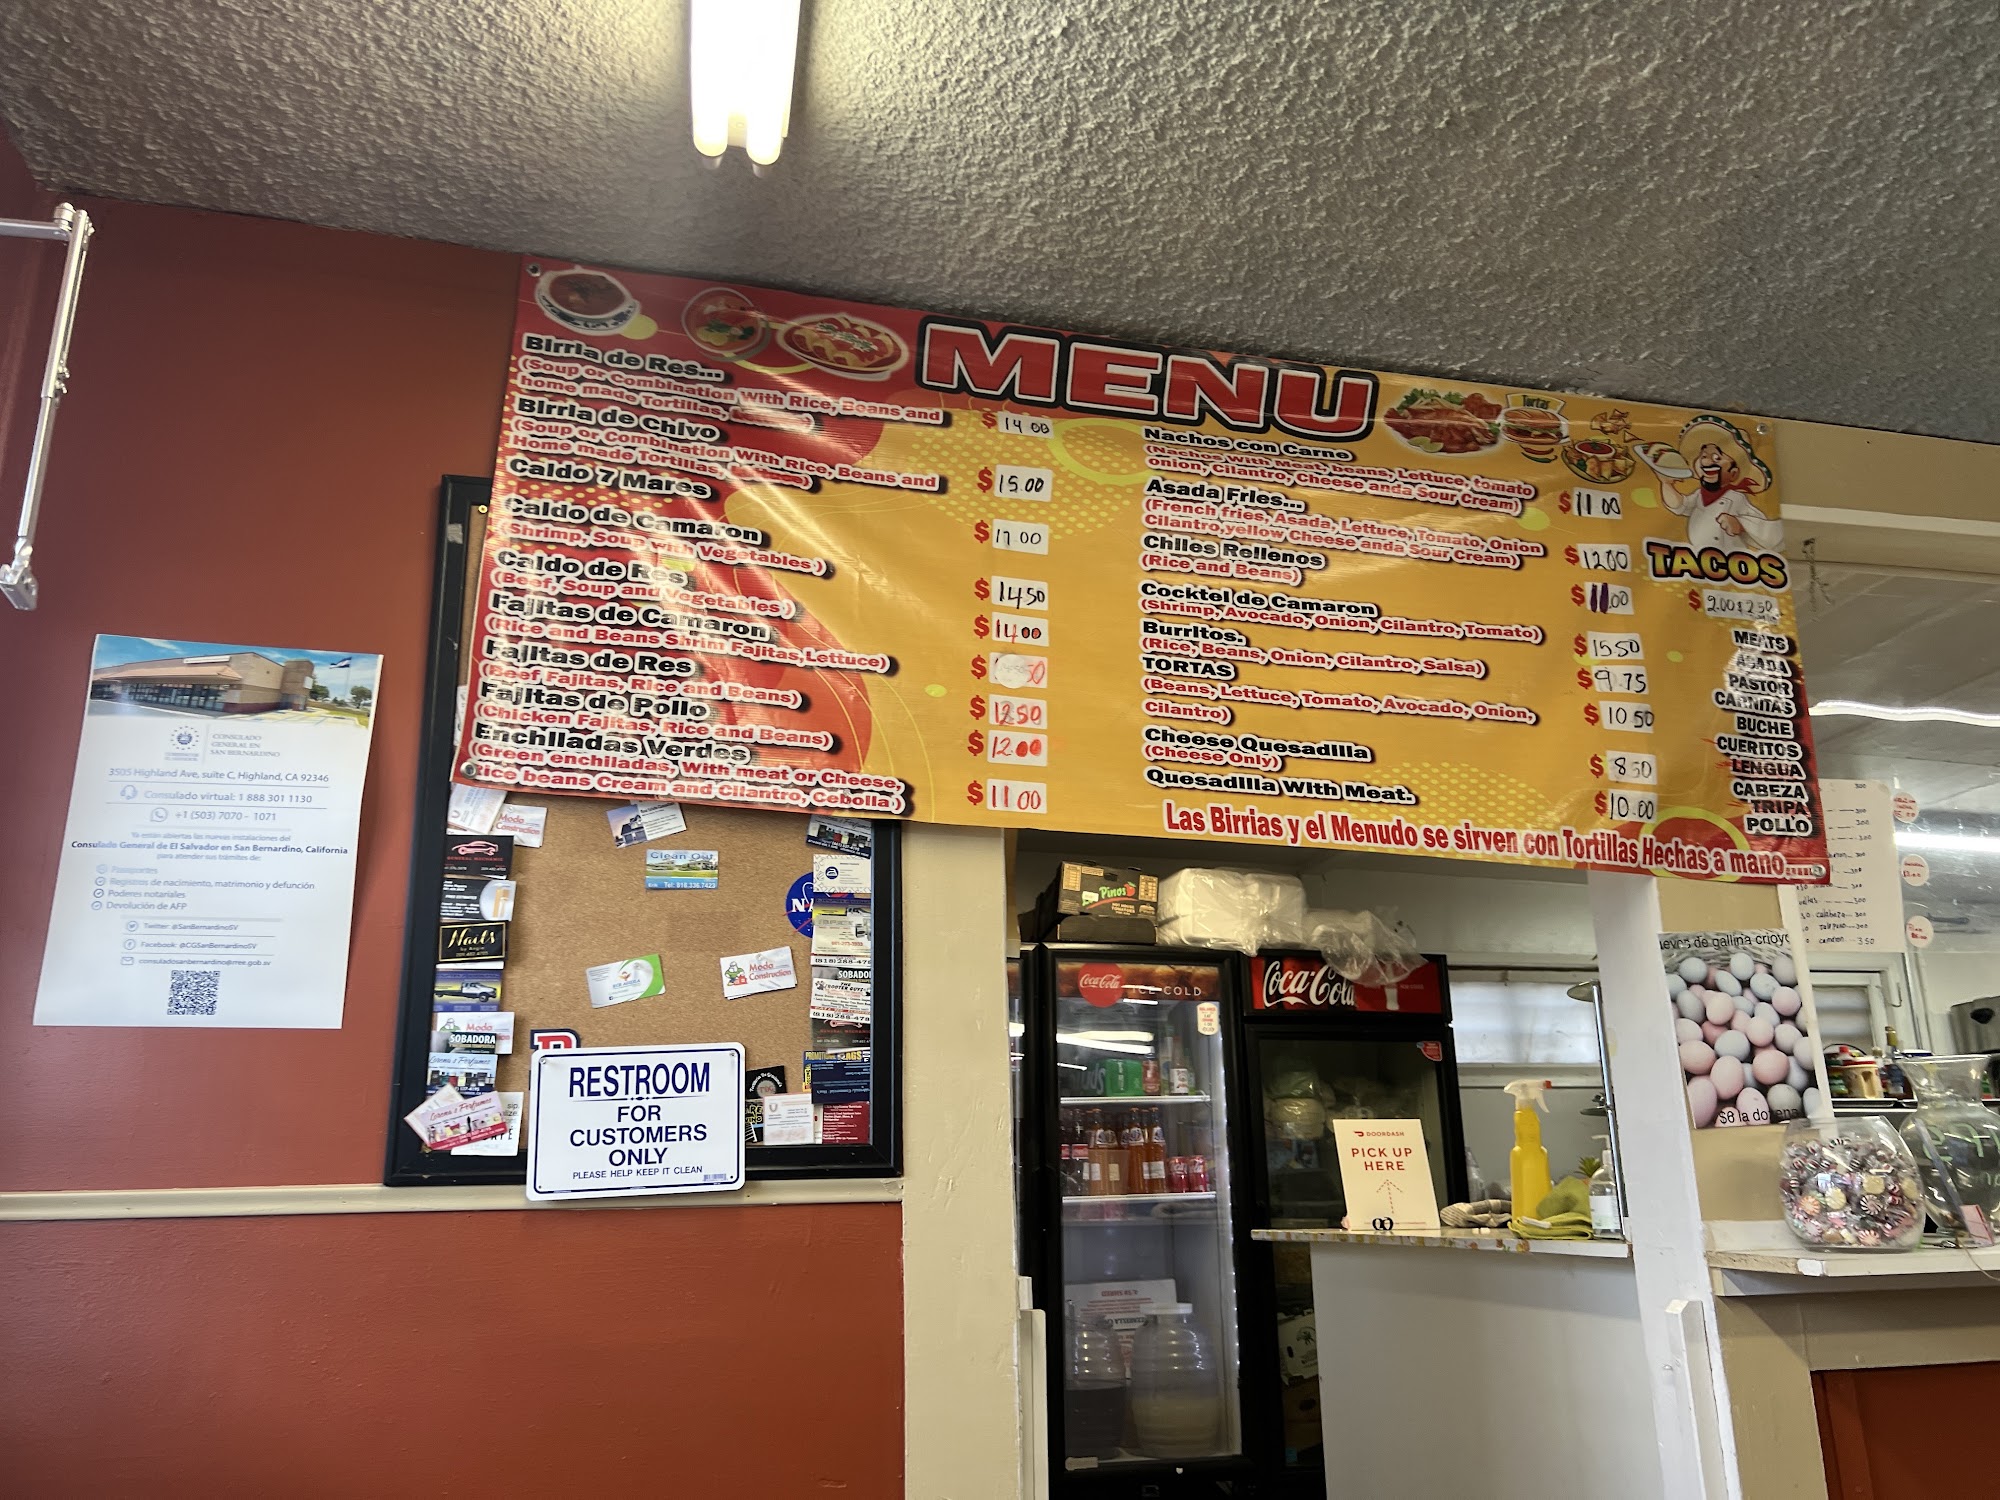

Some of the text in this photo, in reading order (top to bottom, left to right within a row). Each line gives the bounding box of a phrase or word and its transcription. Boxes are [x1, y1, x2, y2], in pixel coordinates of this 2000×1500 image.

[526, 336, 598, 361] Birria
[607, 351, 642, 367] de
[521, 359, 941, 421] (Soup or Combination With Rice, Beans and
[918, 319, 1376, 439] MENU
[519, 399, 593, 421] Birria
[601, 409, 635, 424] de
[643, 417, 717, 439] Chivo
[1144, 428, 1350, 460] Nachos con Carne
[510, 460, 590, 481] Caldo
[599, 468, 615, 484] 7
[622, 473, 709, 497] Mares
[1147, 480, 1219, 499] Asada
[506, 497, 759, 541] Caldo de Camaron
[1144, 535, 1324, 566] Chiles Rellenos
[498, 550, 685, 583] Caldo de Res
[1646, 541, 1788, 589] TACOS
[1141, 583, 1375, 614] Cocktel de Camaron
[492, 593, 767, 638] Fajitas de Camaron
[486, 639, 691, 673] Fajitas de Res
[1143, 638, 1482, 675] (Rice, Beans, Onion, Cilantro, Salsa)
[1143, 657, 1232, 677] TORTAS
[1729, 673, 1790, 696] PASTOR
[481, 682, 707, 717] Fajitas de Pollo
[1143, 678, 1533, 720] (Beans, Lettuce, Tomato, Avocado, Onion,
[1714, 690, 1794, 715] CARNITAS
[1145, 702, 1228, 721] Cilantro)
[1737, 716, 1791, 735] BUCHE
[645, 740, 748, 760] Verdes
[1145, 728, 1368, 759] Cheese Quesadilla
[1717, 735, 1800, 757] CUERITOS
[472, 743, 902, 791] (Green enchiladas, With meat or Cheese,
[1145, 745, 1279, 769] (Cheese Only)
[1732, 758, 1803, 777] LENGUA
[134, 768, 177, 780] Highland
[202, 770, 225, 780] suite
[238, 771, 282, 781] Highland,
[285, 773, 298, 781] CA
[300, 773, 329, 782] 92346
[1147, 769, 1275, 792] Quesadilla
[1283, 780, 1338, 797] With
[144, 790, 312, 803] Consulado virtual: 1 888 301 1130
[1733, 781, 1805, 799] CABEZA
[1752, 799, 1809, 815] TRIPA
[1166, 802, 1726, 871] Las Birrias y el Menudo se sirven con Tortillas Hechas a
[1747, 817, 1809, 834] POLLO
[119, 841, 155, 850] General
[156, 842, 168, 850] de
[170, 842, 178, 850] El
[180, 842, 219, 851] Salvador
[234, 844, 251, 852] San
[305, 845, 348, 854] California
[1694, 936, 1709, 948] de
[1712, 933, 1751, 950] gallina
[1163, 986, 1202, 996] COLD
[450, 1033, 496, 1045] SOBADORA
[569, 1062, 710, 1097] RESTROOM
[617, 1105, 661, 1122] FOR
[570, 1123, 707, 1147] CUSTOMERS
[608, 1147, 668, 1167] ONLY
[1351, 1147, 1412, 1158] PICK UP
[572, 1165, 703, 1180] PLEASE HELP KEEP IT CLEAN
[1364, 1161, 1405, 1171] HERE
